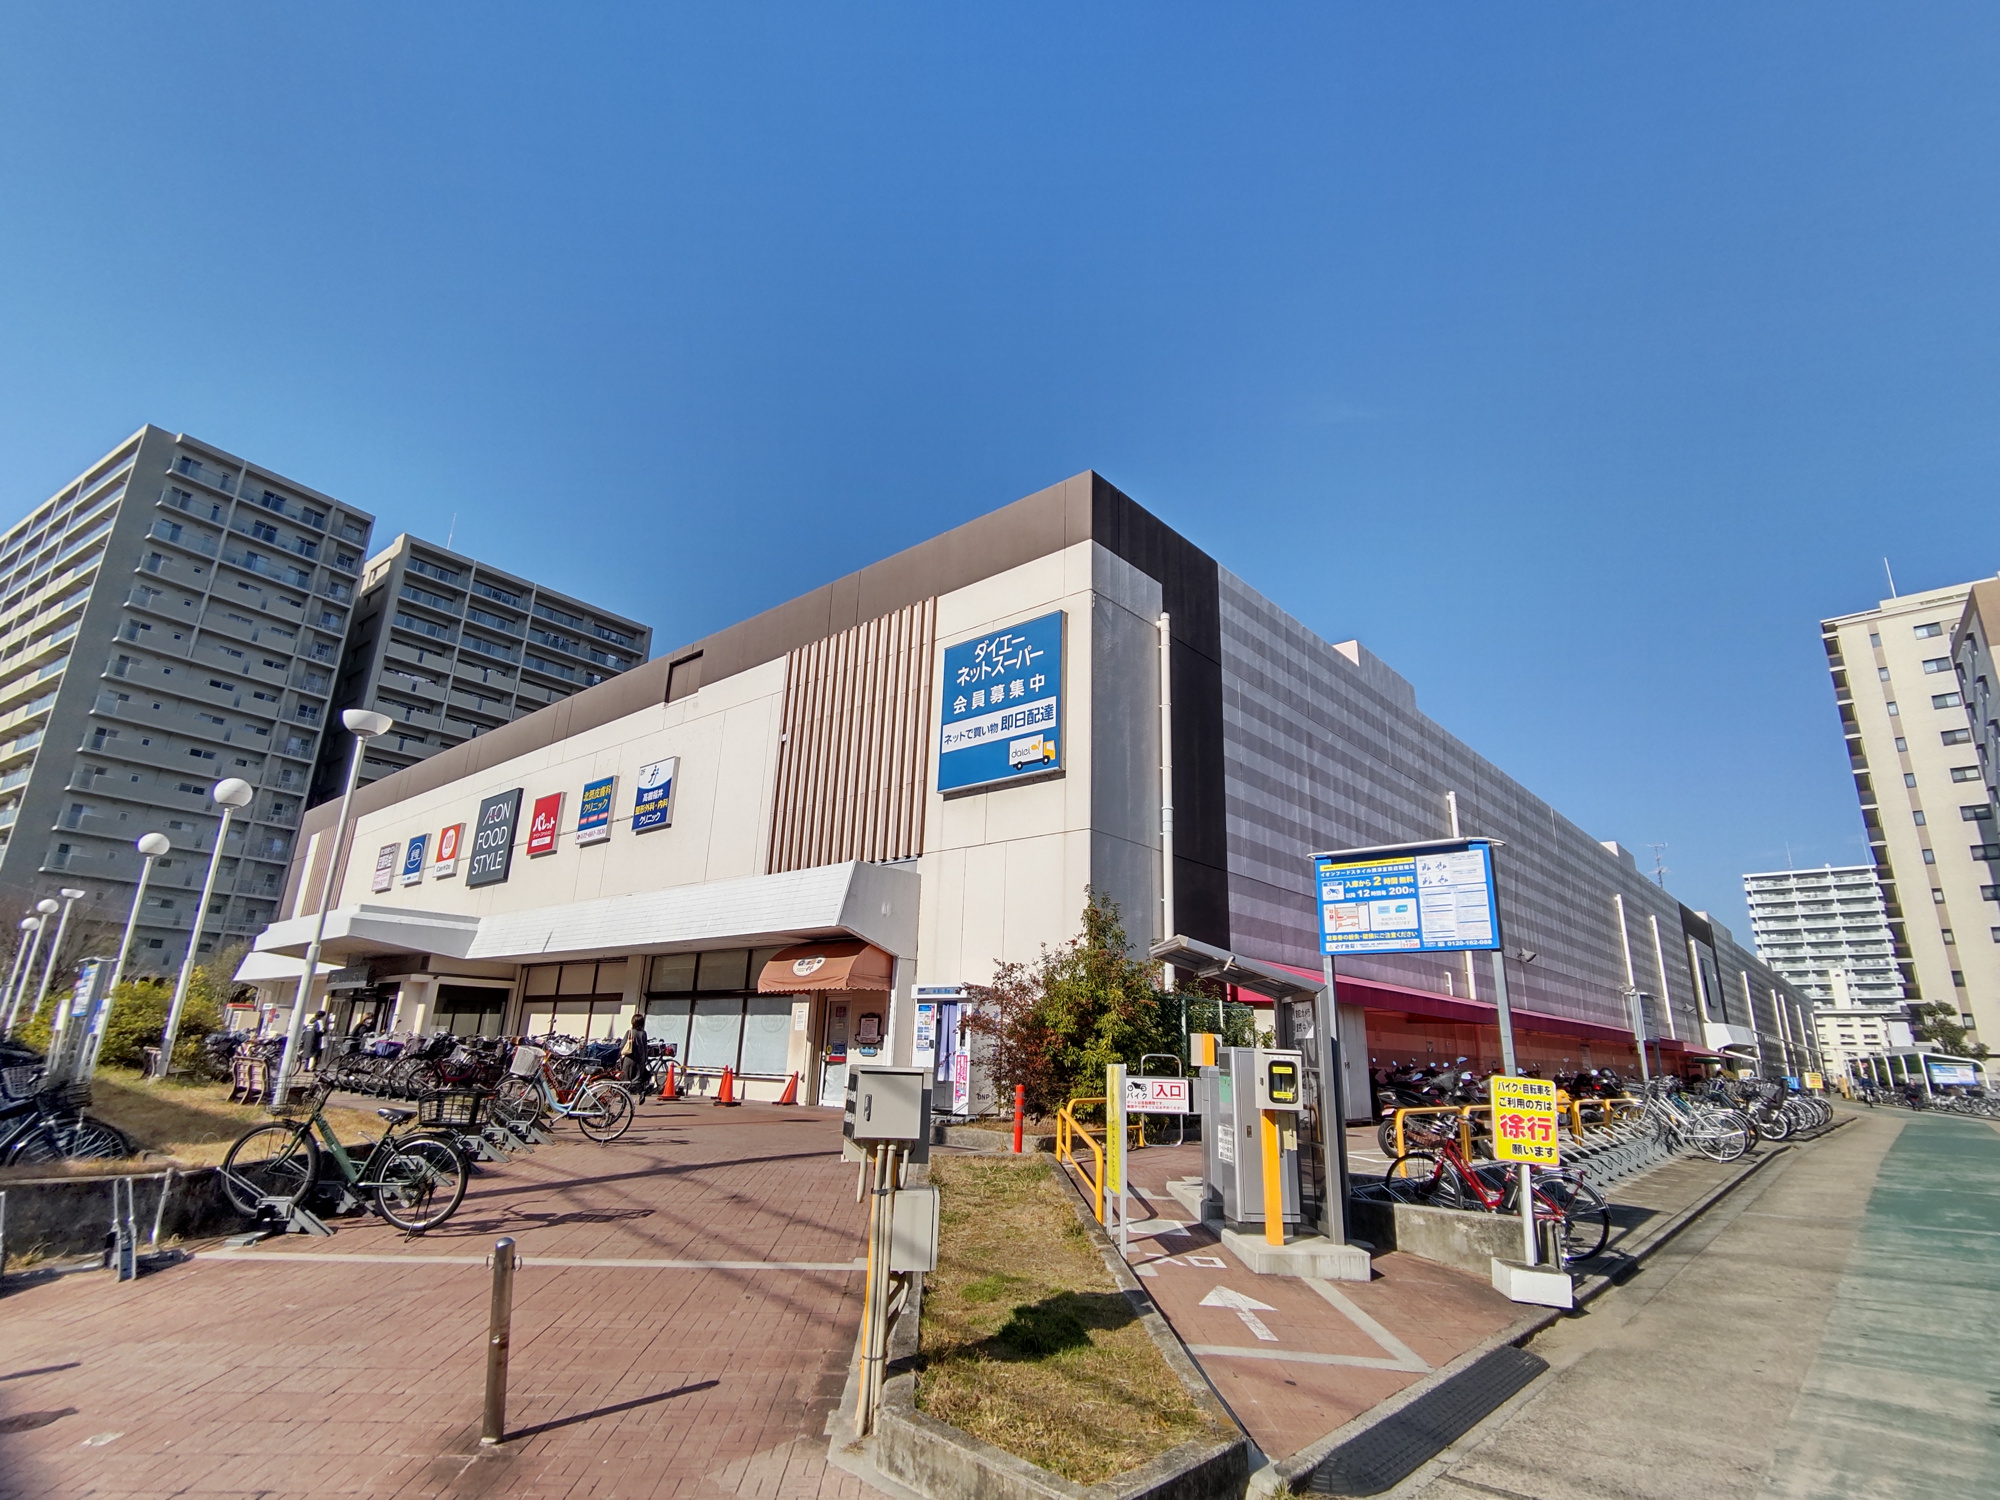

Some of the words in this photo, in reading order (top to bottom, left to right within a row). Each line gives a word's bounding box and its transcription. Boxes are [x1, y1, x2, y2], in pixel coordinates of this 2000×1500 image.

[974, 634, 1026, 664] ダイエー
[956, 645, 1044, 687] ネットスーパー
[953, 673, 1046, 714] 会員募集中
[944, 722, 999, 745] ネットで買い物
[1000, 704, 1054, 731] 即日配達
[1011, 745, 1031, 759] daiei
[582, 798, 608, 815] クリニック
[639, 812, 661, 826] クリニック
[476, 826, 508, 851] FOOD
[472, 850, 504, 875] STYLE
[1373, 876, 1382, 886] 2
[1155, 1084, 1181, 1098] 入口
[1498, 1082, 1551, 1096] バイク・自転車を
[1499, 1097, 1552, 1111] ご利用の方は
[1500, 1114, 1552, 1141] 徐行
[1511, 1143, 1555, 1157] 願います
